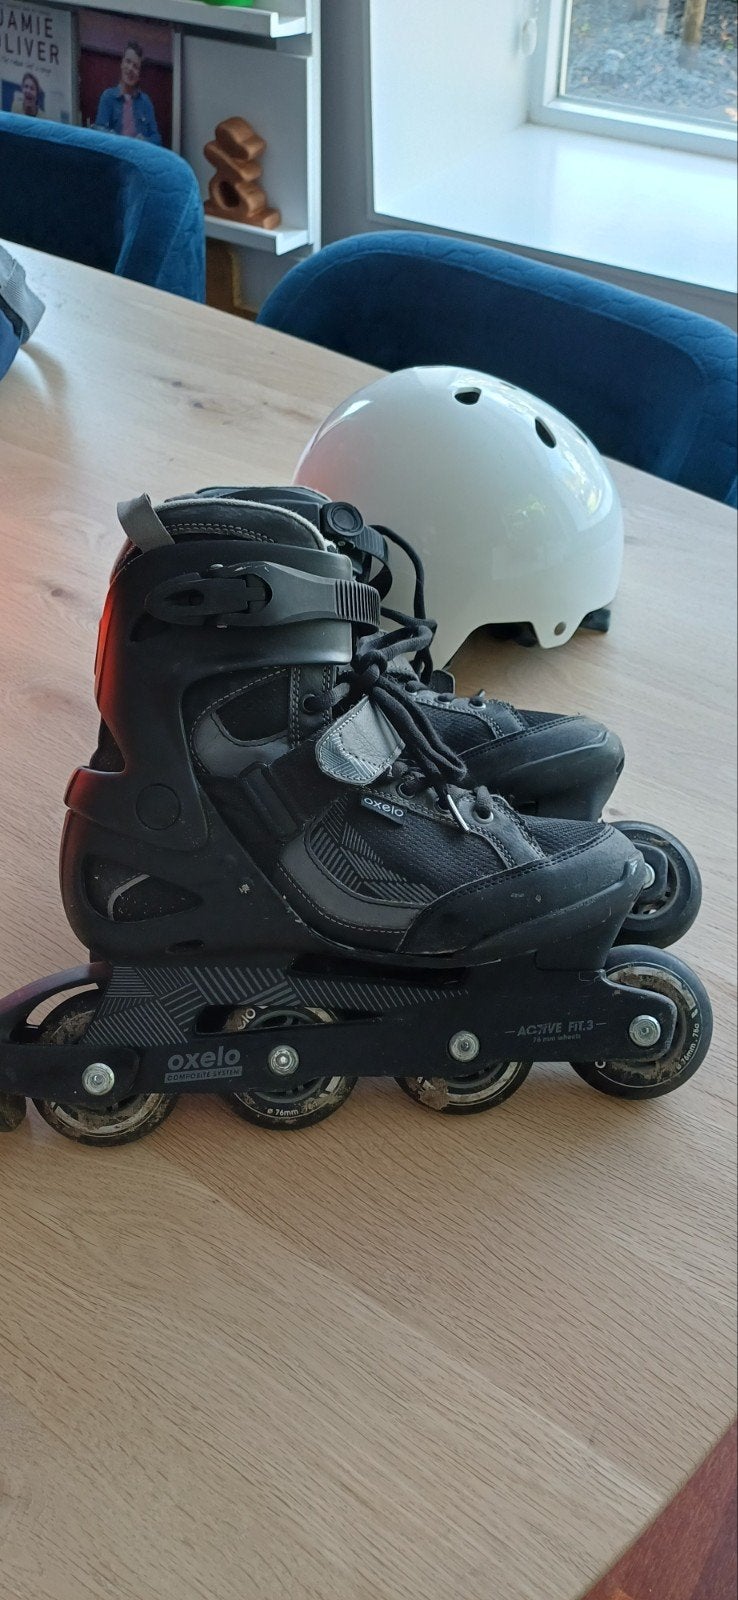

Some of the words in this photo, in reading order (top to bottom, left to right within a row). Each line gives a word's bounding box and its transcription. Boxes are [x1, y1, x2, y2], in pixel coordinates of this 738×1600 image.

[0, 8, 53, 39] JAMIE
[0, 31, 60, 66] LIVER
[364, 797, 404, 817] oxelo
[516, 1022, 562, 1037] ACTIVE
[568, 1019, 594, 1033] FIT.3
[167, 1045, 241, 1071] oxelo
[680, 1043, 696, 1065] 76mm
[167, 1070, 209, 1082] COMPOSITE
[209, 1067, 240, 1078] SYSTEM
[275, 1108, 299, 1116] 76mm
